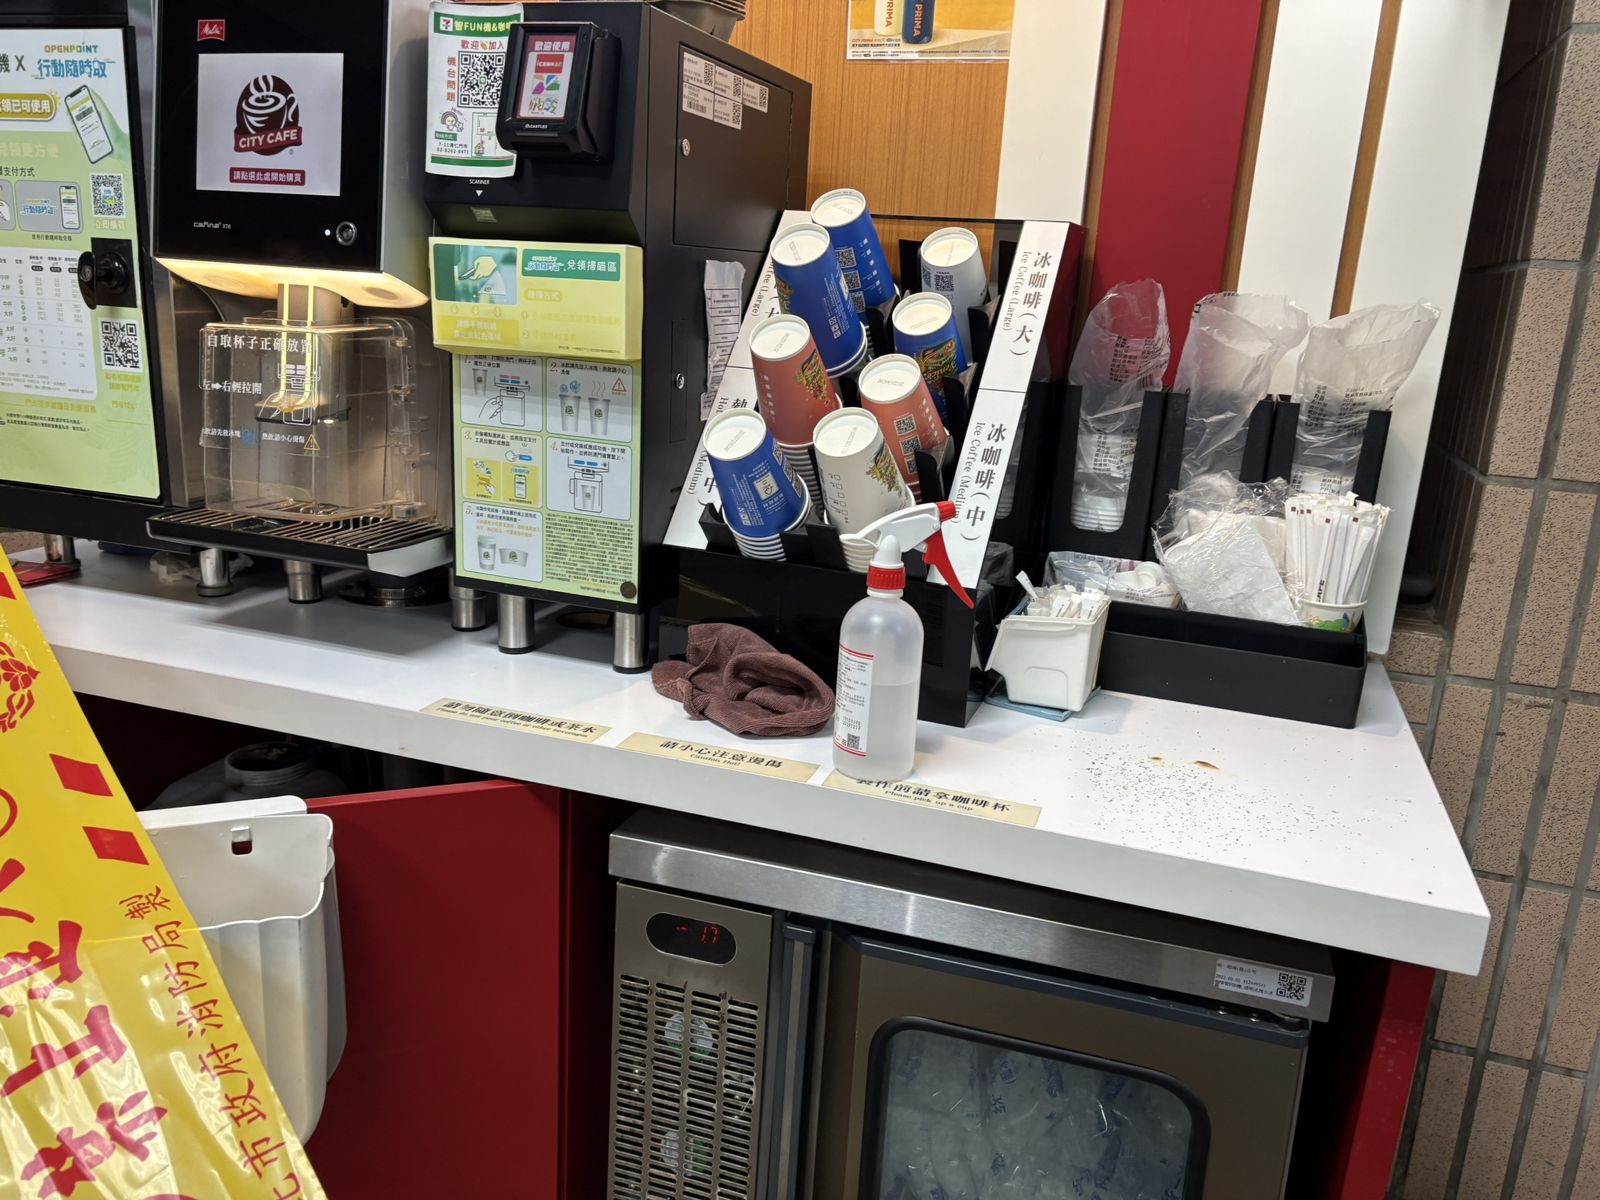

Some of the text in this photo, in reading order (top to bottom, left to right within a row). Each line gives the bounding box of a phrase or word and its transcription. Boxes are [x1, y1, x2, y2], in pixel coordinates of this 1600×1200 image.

[913, 3, 923, 37] PRIMA
[460, 40, 505, 50] 歡迎 加入
[534, 41, 571, 52] 歡迎使用
[37, 58, 108, 78] 行動隨時取
[447, 56, 457, 102] 機台問題
[0, 99, 51, 113] 領已可使用
[239, 129, 298, 149] CITY CAFE
[1002, 251, 1032, 331] Ice Coffee (Large)
[973, 422, 986, 436] Ice
[963, 438, 981, 473] Coffee
[690, 753, 741, 767] Caution Hot!
[884, 789, 913, 798] Please
[913, 794, 932, 804] pick
[957, 804, 973, 812] cup
